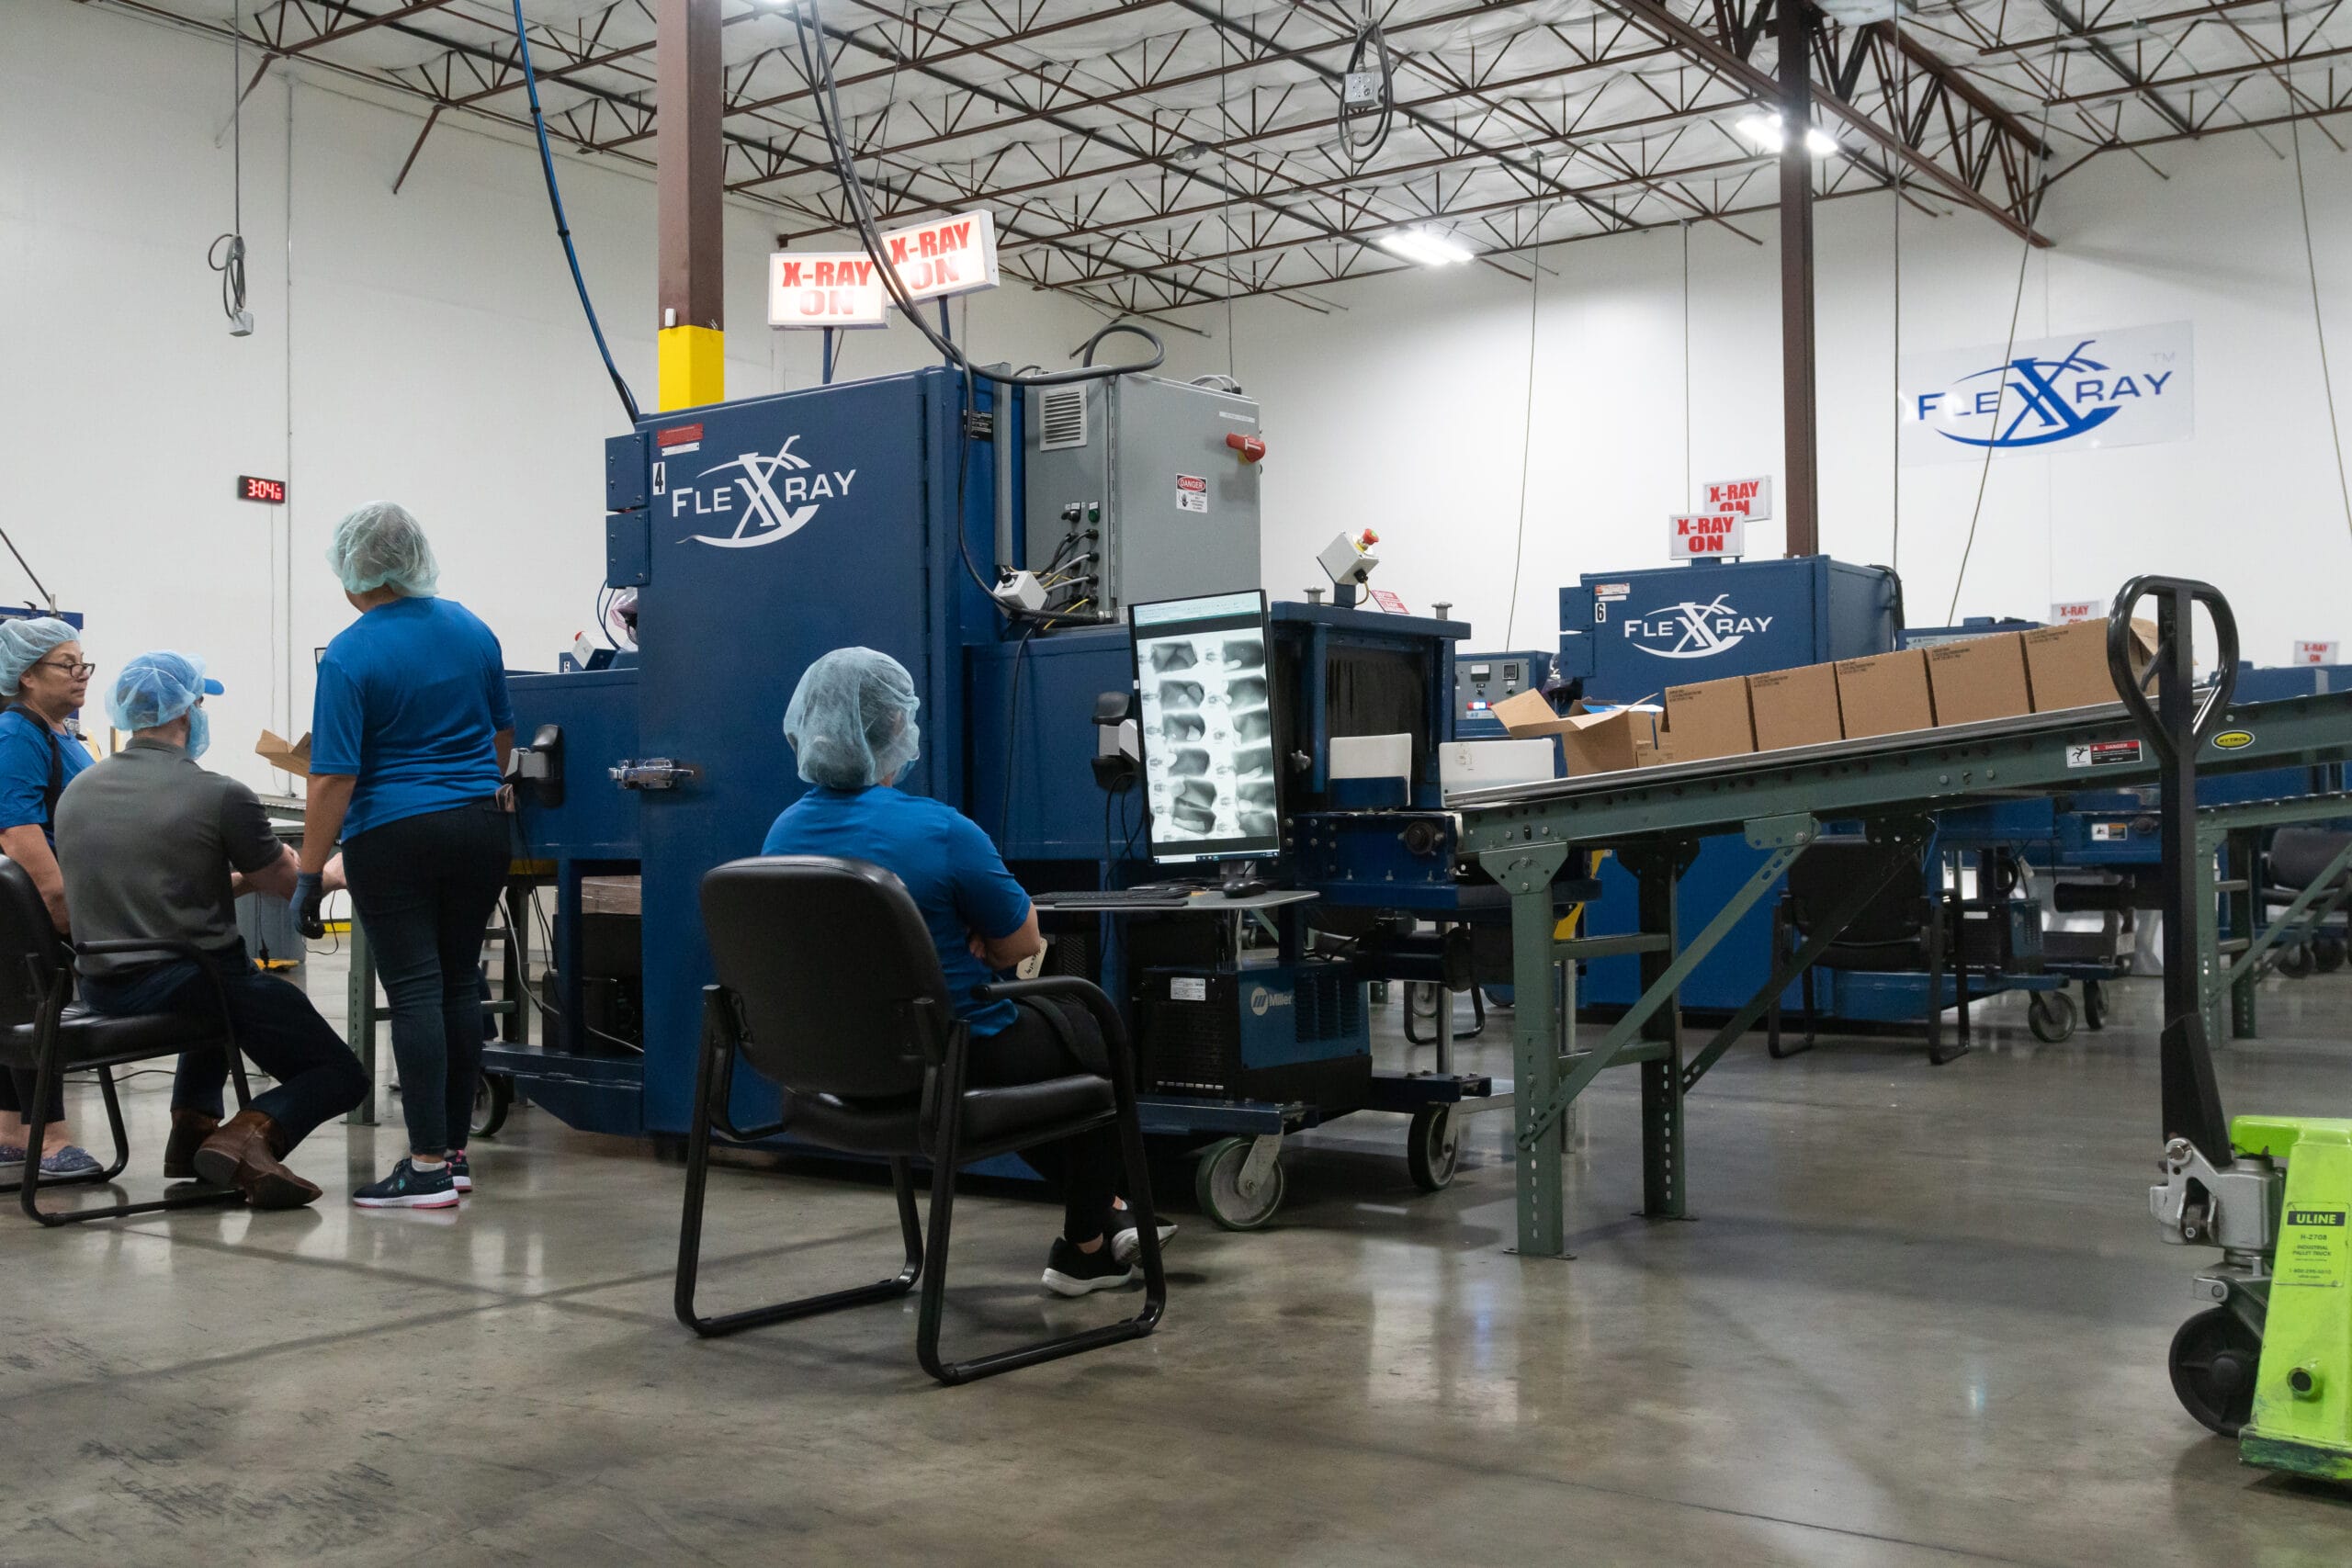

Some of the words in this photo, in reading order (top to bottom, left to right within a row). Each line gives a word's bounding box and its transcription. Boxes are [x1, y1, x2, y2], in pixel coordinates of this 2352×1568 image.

[889, 221, 971, 265] X-RAY
[782, 261, 873, 288] X-RAY
[910, 257, 959, 290] ON
[799, 289, 854, 316] ON
[654, 463, 663, 493] 4
[1180, 479, 1204, 490] DANGER
[248, 479, 274, 499] 3:04
[1709, 480, 1759, 502] X-RAY
[1719, 499, 1749, 515] ON
[1677, 516, 1735, 536] X-RAY
[1688, 535, 1724, 553] ON
[1597, 603, 1604, 621] 6
[2060, 605, 2089, 617] X-RAY
[1269, 993, 1293, 1007] Miller
[2296, 1213, 2337, 1224] ULINE
